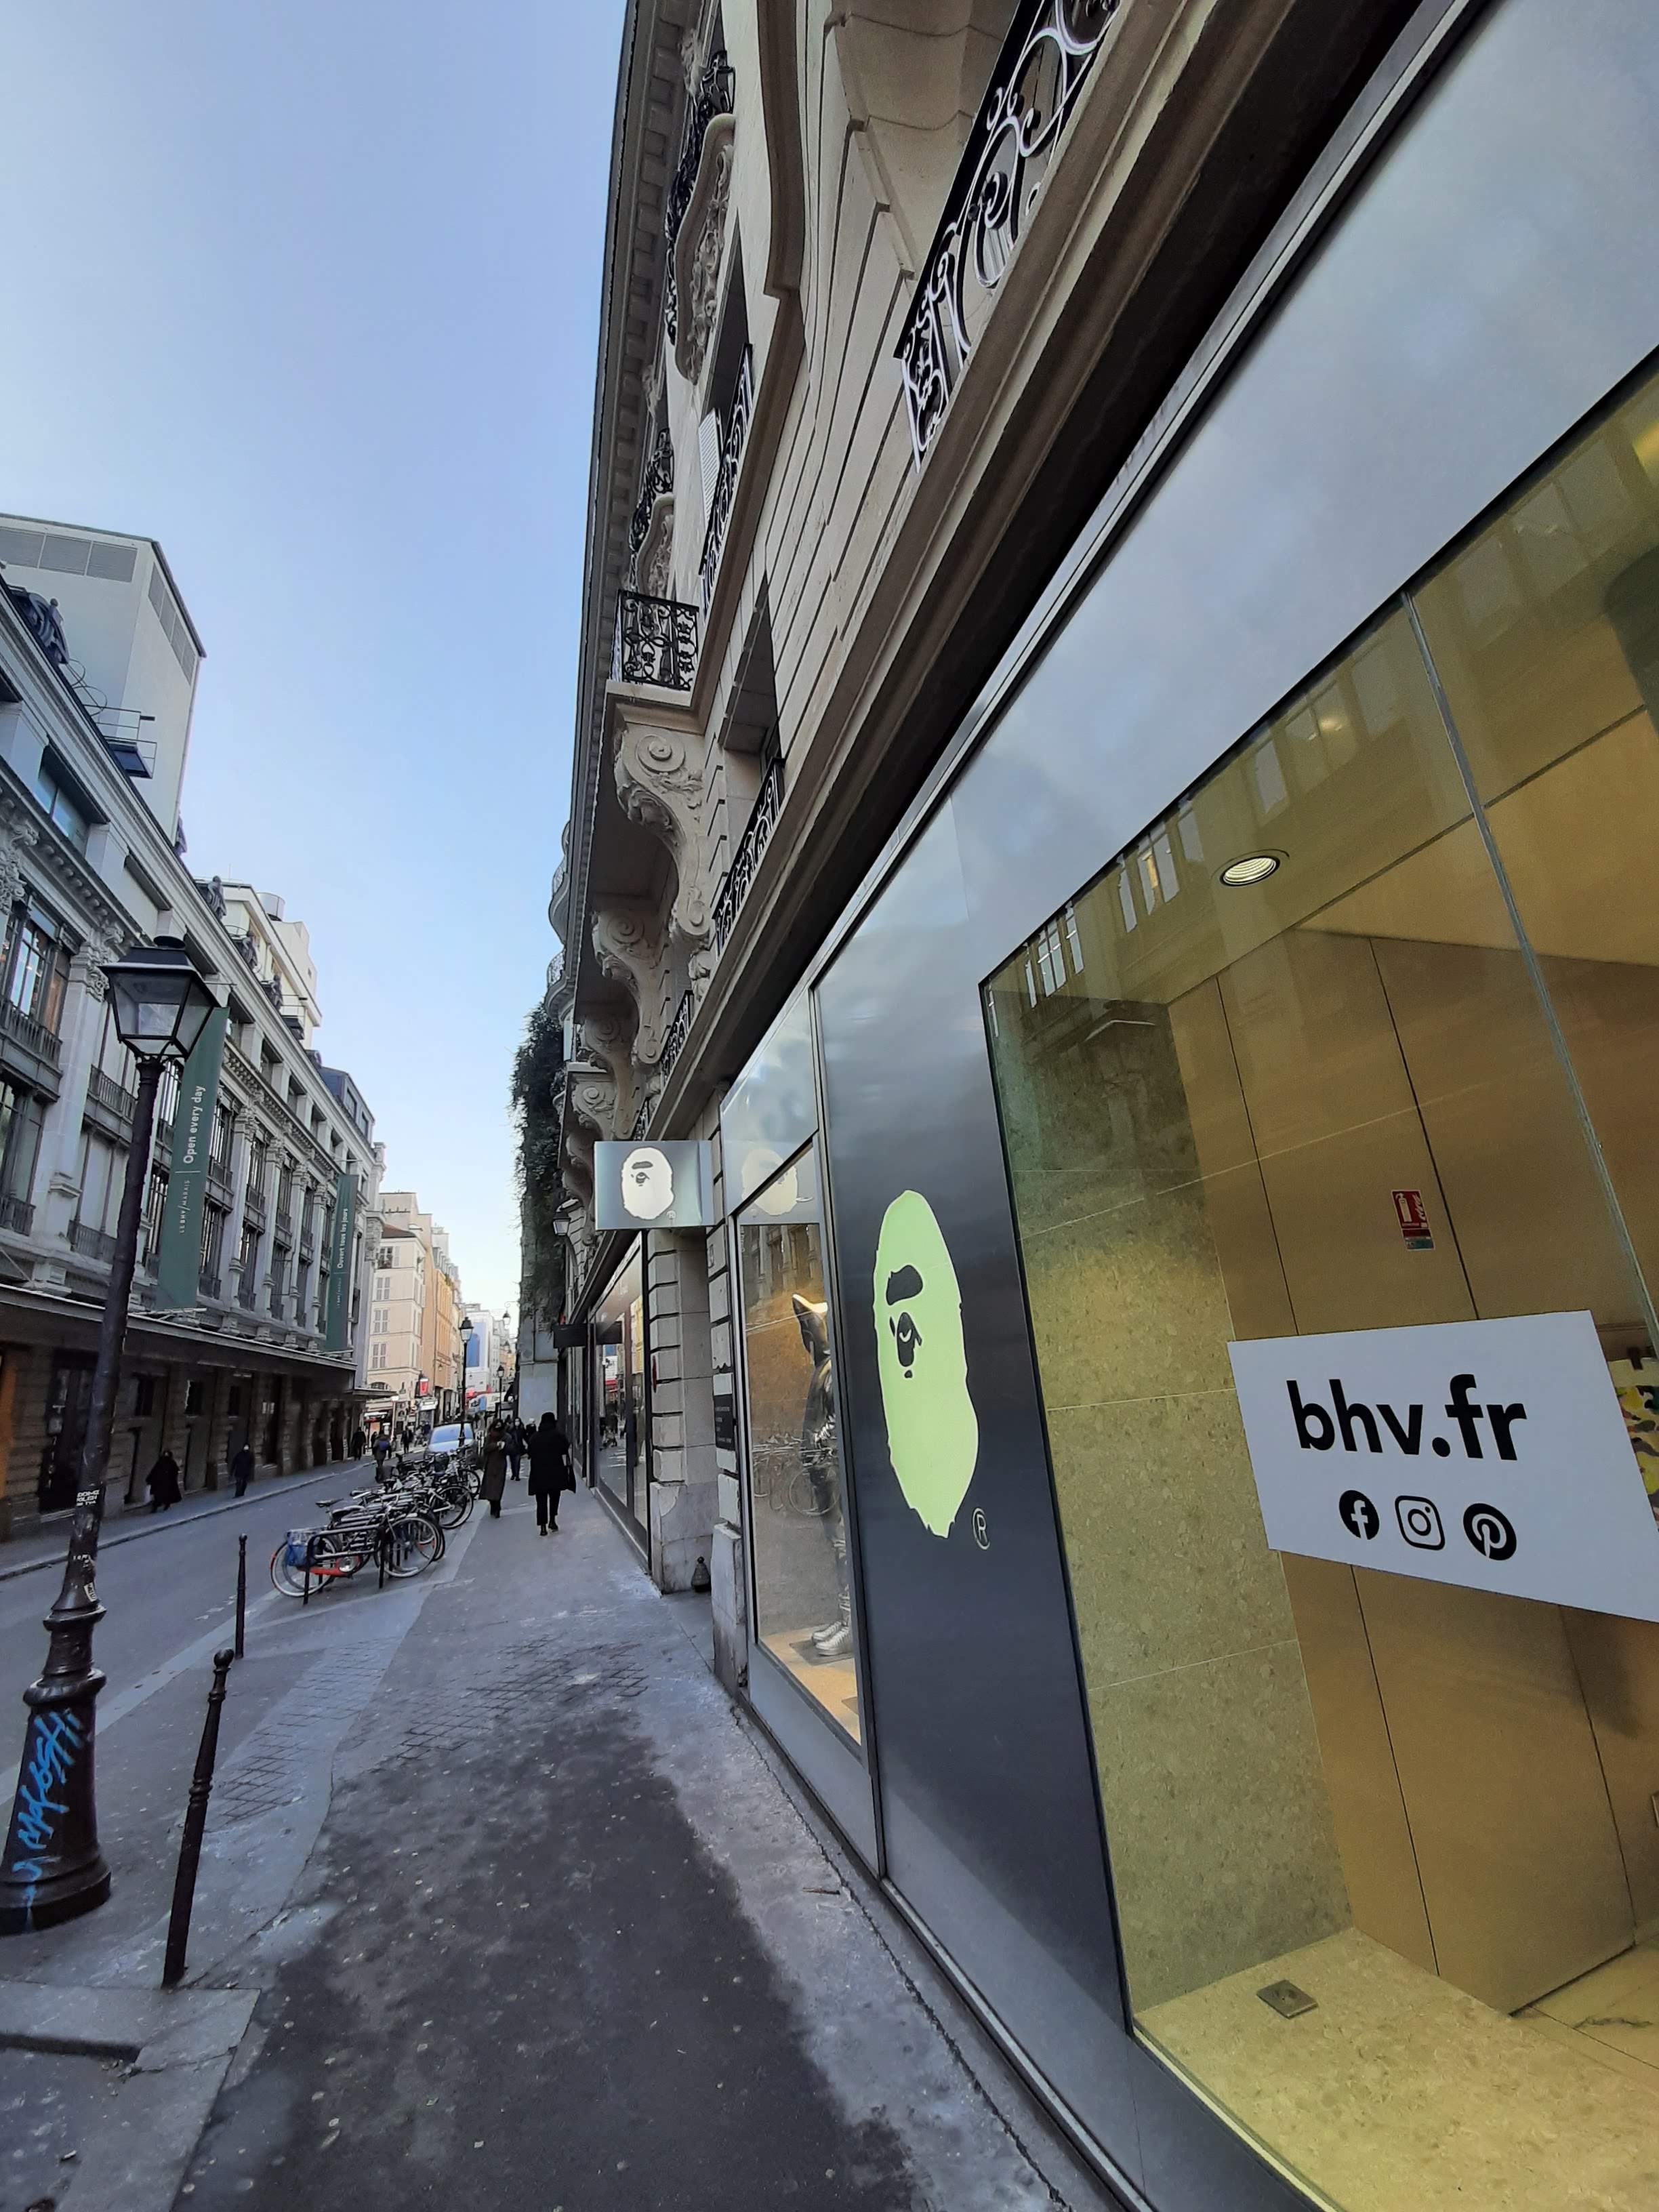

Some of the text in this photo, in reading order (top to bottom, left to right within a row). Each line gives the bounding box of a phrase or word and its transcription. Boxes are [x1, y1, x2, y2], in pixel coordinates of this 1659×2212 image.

[183, 1085, 206, 1164] Open every day
[337, 1247, 346, 1269] Ouvert
[1286, 1374, 1527, 1460] bhv.fr
